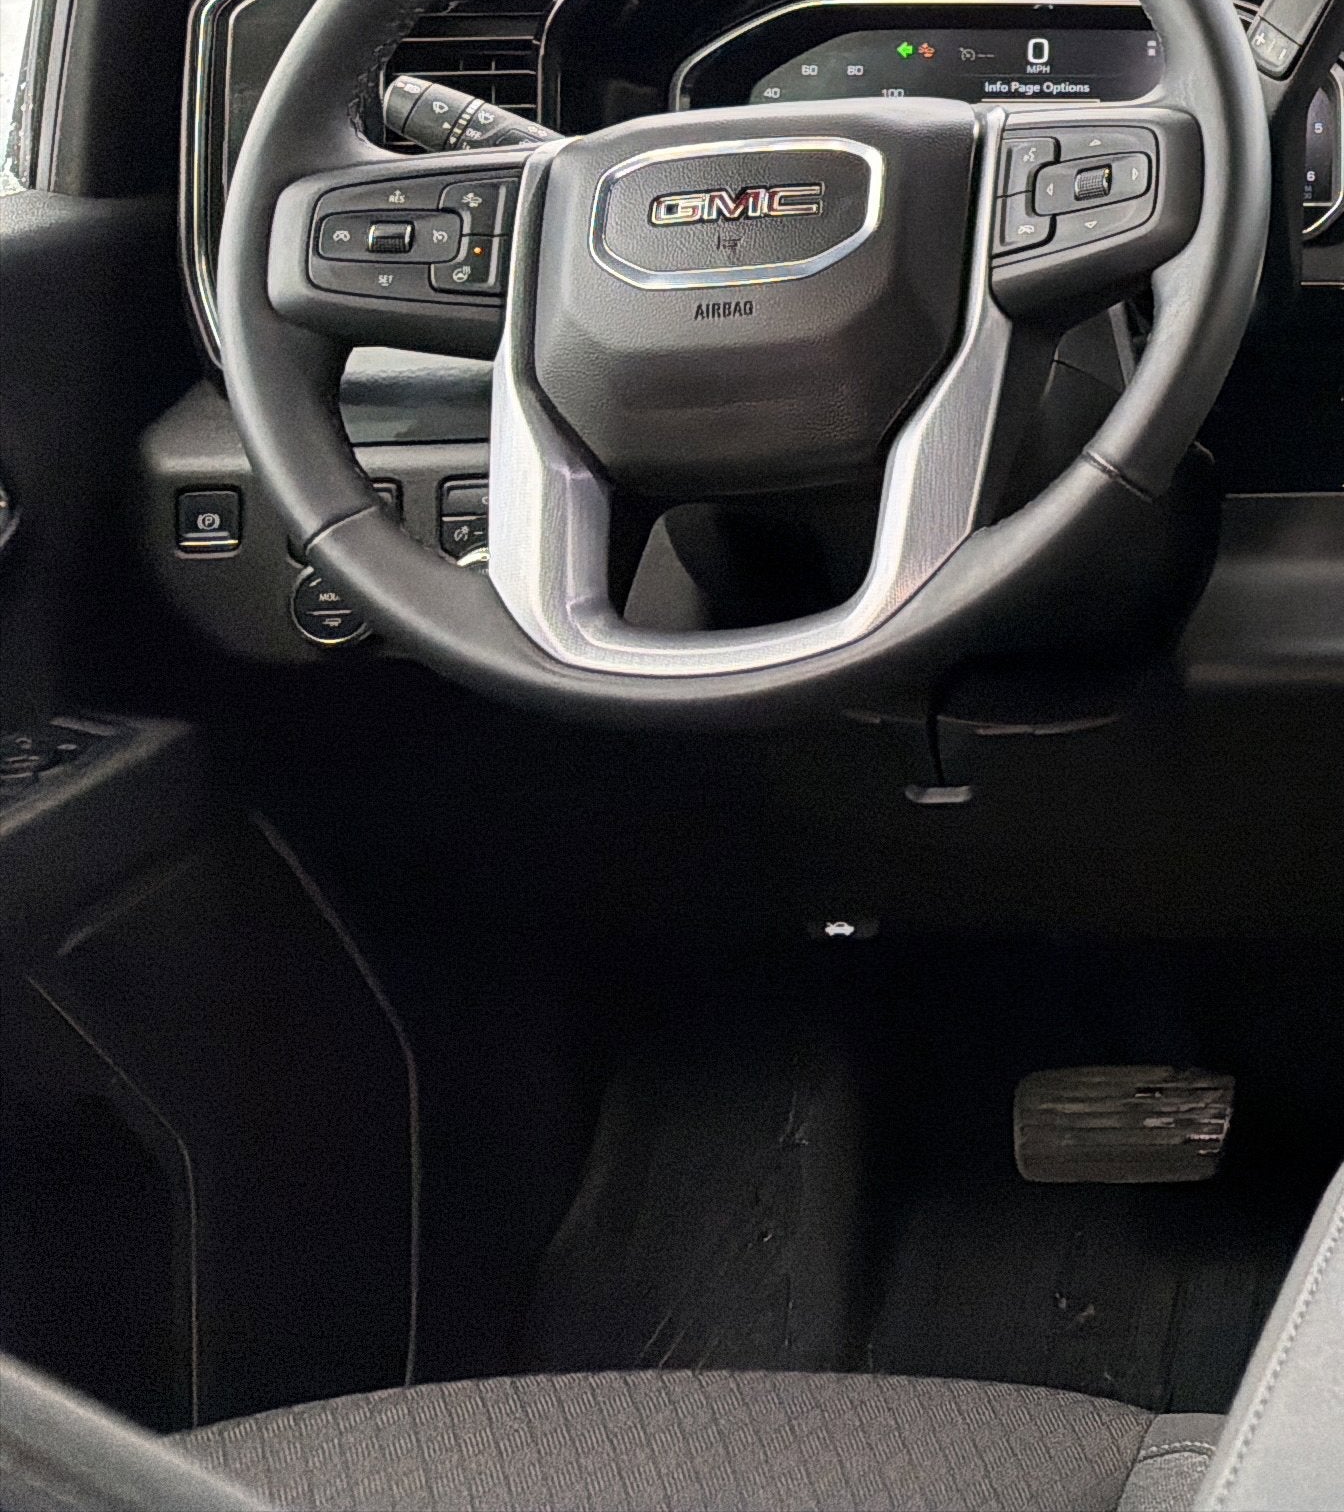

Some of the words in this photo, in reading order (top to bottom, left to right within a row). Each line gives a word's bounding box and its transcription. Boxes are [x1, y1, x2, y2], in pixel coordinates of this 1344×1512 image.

[1027, 38, 1049, 64] 0
[801, 65, 818, 76] 60
[846, 65, 863, 76] 80
[1026, 65, 1050, 75] MPH
[763, 88, 780, 99] 40
[881, 88, 904, 99] 100
[985, 81, 1008, 94] Info
[1011, 82, 1042, 96] Page
[1043, 81, 1090, 95] Options
[1314, 122, 1323, 134] 5
[1306, 170, 1316, 182] 6
[388, 194, 406, 204] RES
[650, 184, 824, 226] GMC
[378, 274, 394, 285] SET
[694, 300, 754, 321] AIRBAG
